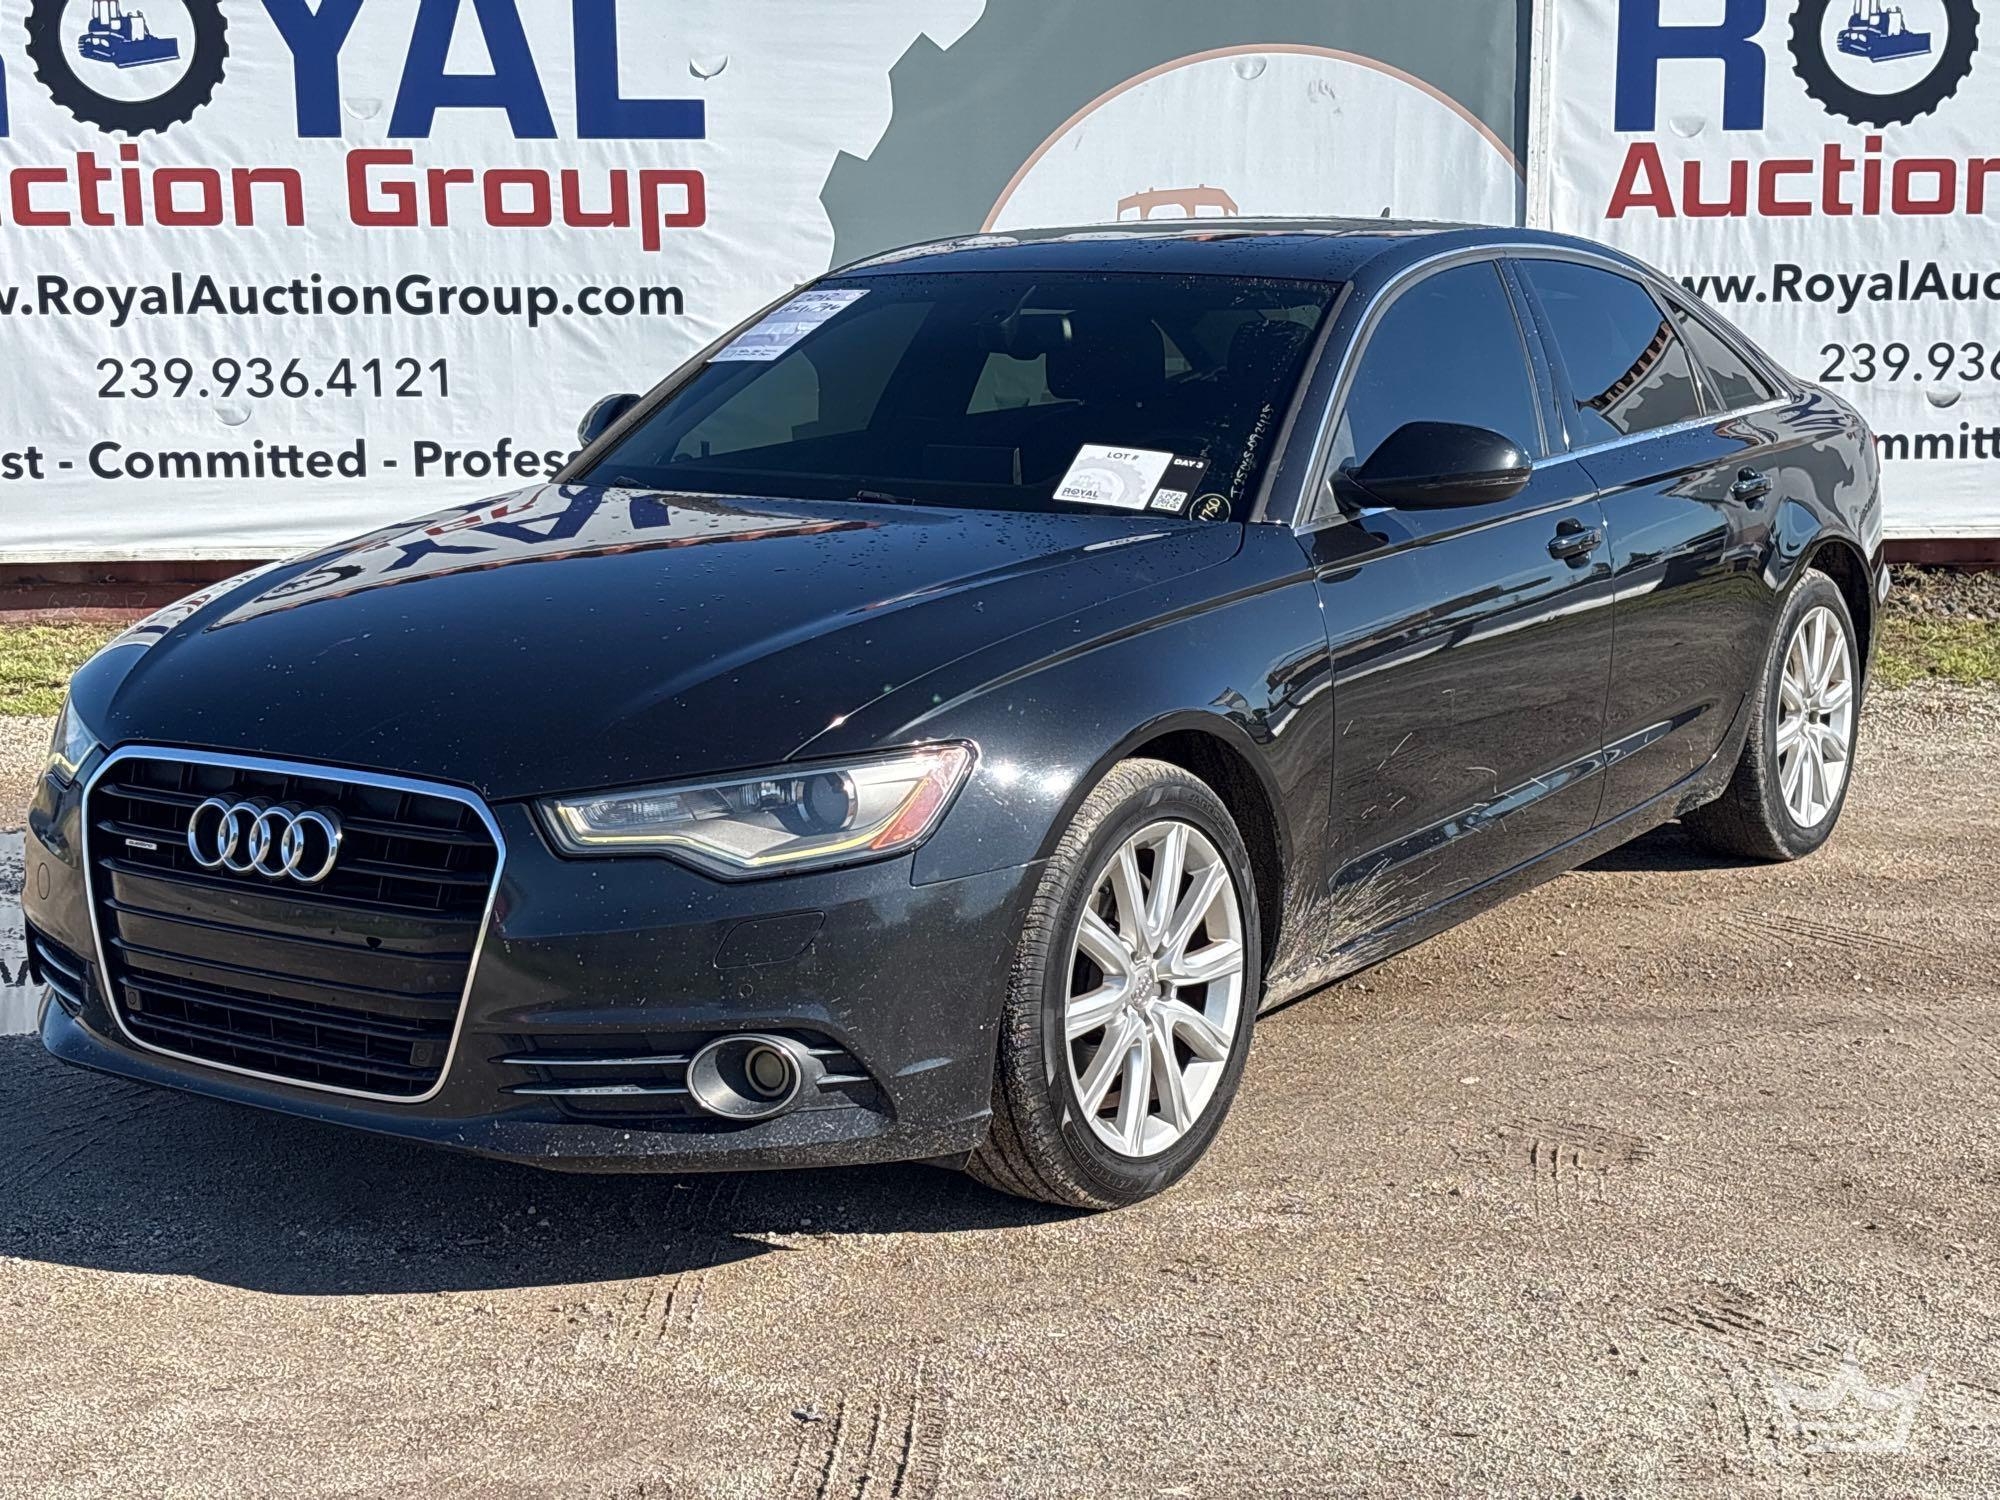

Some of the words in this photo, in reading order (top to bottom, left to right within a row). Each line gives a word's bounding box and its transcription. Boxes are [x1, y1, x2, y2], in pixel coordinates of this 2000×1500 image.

[0, 144, 305, 227] ction
[347, 149, 706, 251] Group
[97, 358, 450, 398] 239.936.4121
[88, 439, 367, 480] Committed
[1106, 451, 1130, 461] LOT
[1173, 458, 1197, 468] DAY
[1062, 487, 1099, 498] ROYAL
